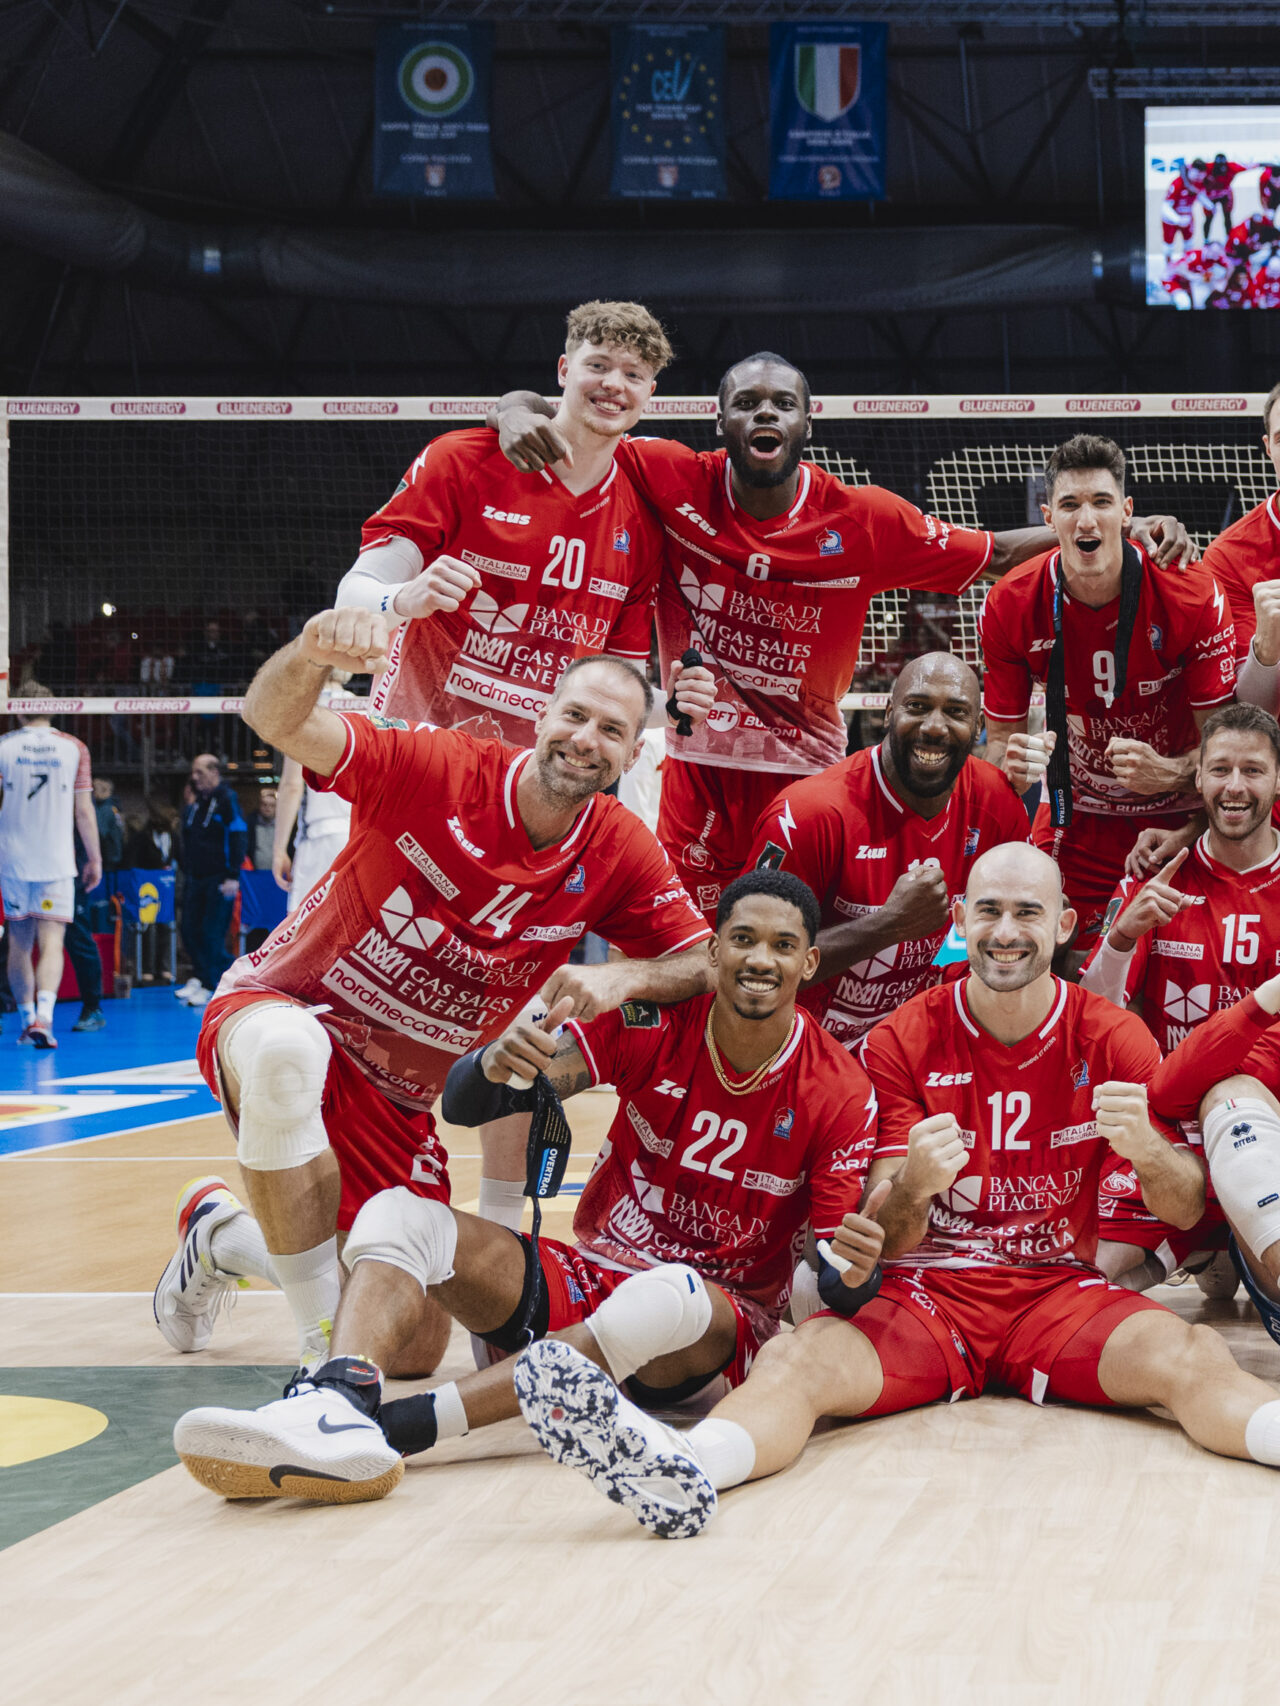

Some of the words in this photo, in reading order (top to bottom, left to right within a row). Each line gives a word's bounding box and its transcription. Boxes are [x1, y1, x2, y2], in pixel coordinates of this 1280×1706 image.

[8, 403, 76, 414] BLUENERGY
[114, 403, 183, 414] BLUENERGY
[220, 402, 289, 414] BLUENERGY
[326, 402, 395, 414] BLUENERGY
[432, 402, 497, 414] BLUENERG
[645, 401, 713, 413] BLUENERGY
[857, 401, 926, 413] BLUENERGY
[963, 400, 1032, 411] BLUENERGY
[1069, 400, 1138, 411] BLUENERGY
[1175, 399, 1244, 411] BLUENERGY
[482, 505, 532, 526] Zeus
[675, 502, 718, 537] Zeus
[476, 556, 528, 574] ITALIANA
[541, 535, 586, 590] 20
[746, 553, 772, 582] 6
[728, 603, 822, 635] PIACENZA
[731, 590, 794, 619] BANCA
[801, 606, 823, 620] DI
[528, 619, 606, 651] PIACENZA
[533, 605, 588, 629] BANCA
[594, 618, 610, 636] DI
[513, 645, 554, 667] GAS
[718, 625, 755, 647] GAS
[758, 635, 812, 659] SALES
[1029, 638, 1056, 653] Ze
[713, 640, 808, 675] ENERGIA
[1092, 650, 1116, 698] 9
[9, 700, 81, 712] BLUENERGY
[117, 700, 186, 711] BLUENERGY
[331, 700, 370, 711] BLUEN
[450, 672, 545, 713] nordmecc
[707, 709, 736, 723] BFT
[1090, 712, 1151, 731] BANCA
[27, 774, 48, 801] 7
[1057, 789, 1065, 825] OVERTRAQ
[446, 815, 486, 859] Zeus
[408, 849, 455, 901] ASSICURAZIONI
[411, 841, 457, 895] ITALIANA
[653, 885, 688, 907] ARA
[469, 883, 534, 939] 14
[903, 937, 940, 957] BANC
[1158, 941, 1201, 952] ITALIANA
[1222, 914, 1261, 965] 15
[437, 949, 530, 988] PIACENZA
[445, 933, 517, 973] BANCA
[519, 959, 543, 976] DI
[410, 964, 454, 997] GAS
[454, 988, 514, 1017] SALES
[885, 979, 913, 996] GAS
[1218, 985, 1256, 1000] BAN
[329, 965, 475, 1051] nordmeccanica
[398, 980, 498, 1027] ENERGIA
[654, 1078, 688, 1099] Ze
[987, 1091, 1031, 1150] 12
[680, 1110, 748, 1181] 22
[832, 1137, 876, 1159] IVEC
[1061, 1131, 1099, 1144] ASSICURAZ
[1232, 1133, 1257, 1149] errea
[539, 1148, 558, 1197] OVERTRAQ
[829, 1158, 869, 1173] ARA
[990, 1175, 1058, 1194] BANCA
[1064, 1167, 1083, 1188] DI
[987, 1186, 1080, 1212] PIACENZA
[667, 1210, 767, 1248] PIACENZA
[671, 1193, 743, 1229] BANCA
[751, 1218, 772, 1236] DI
[655, 1232, 693, 1260] GAS
